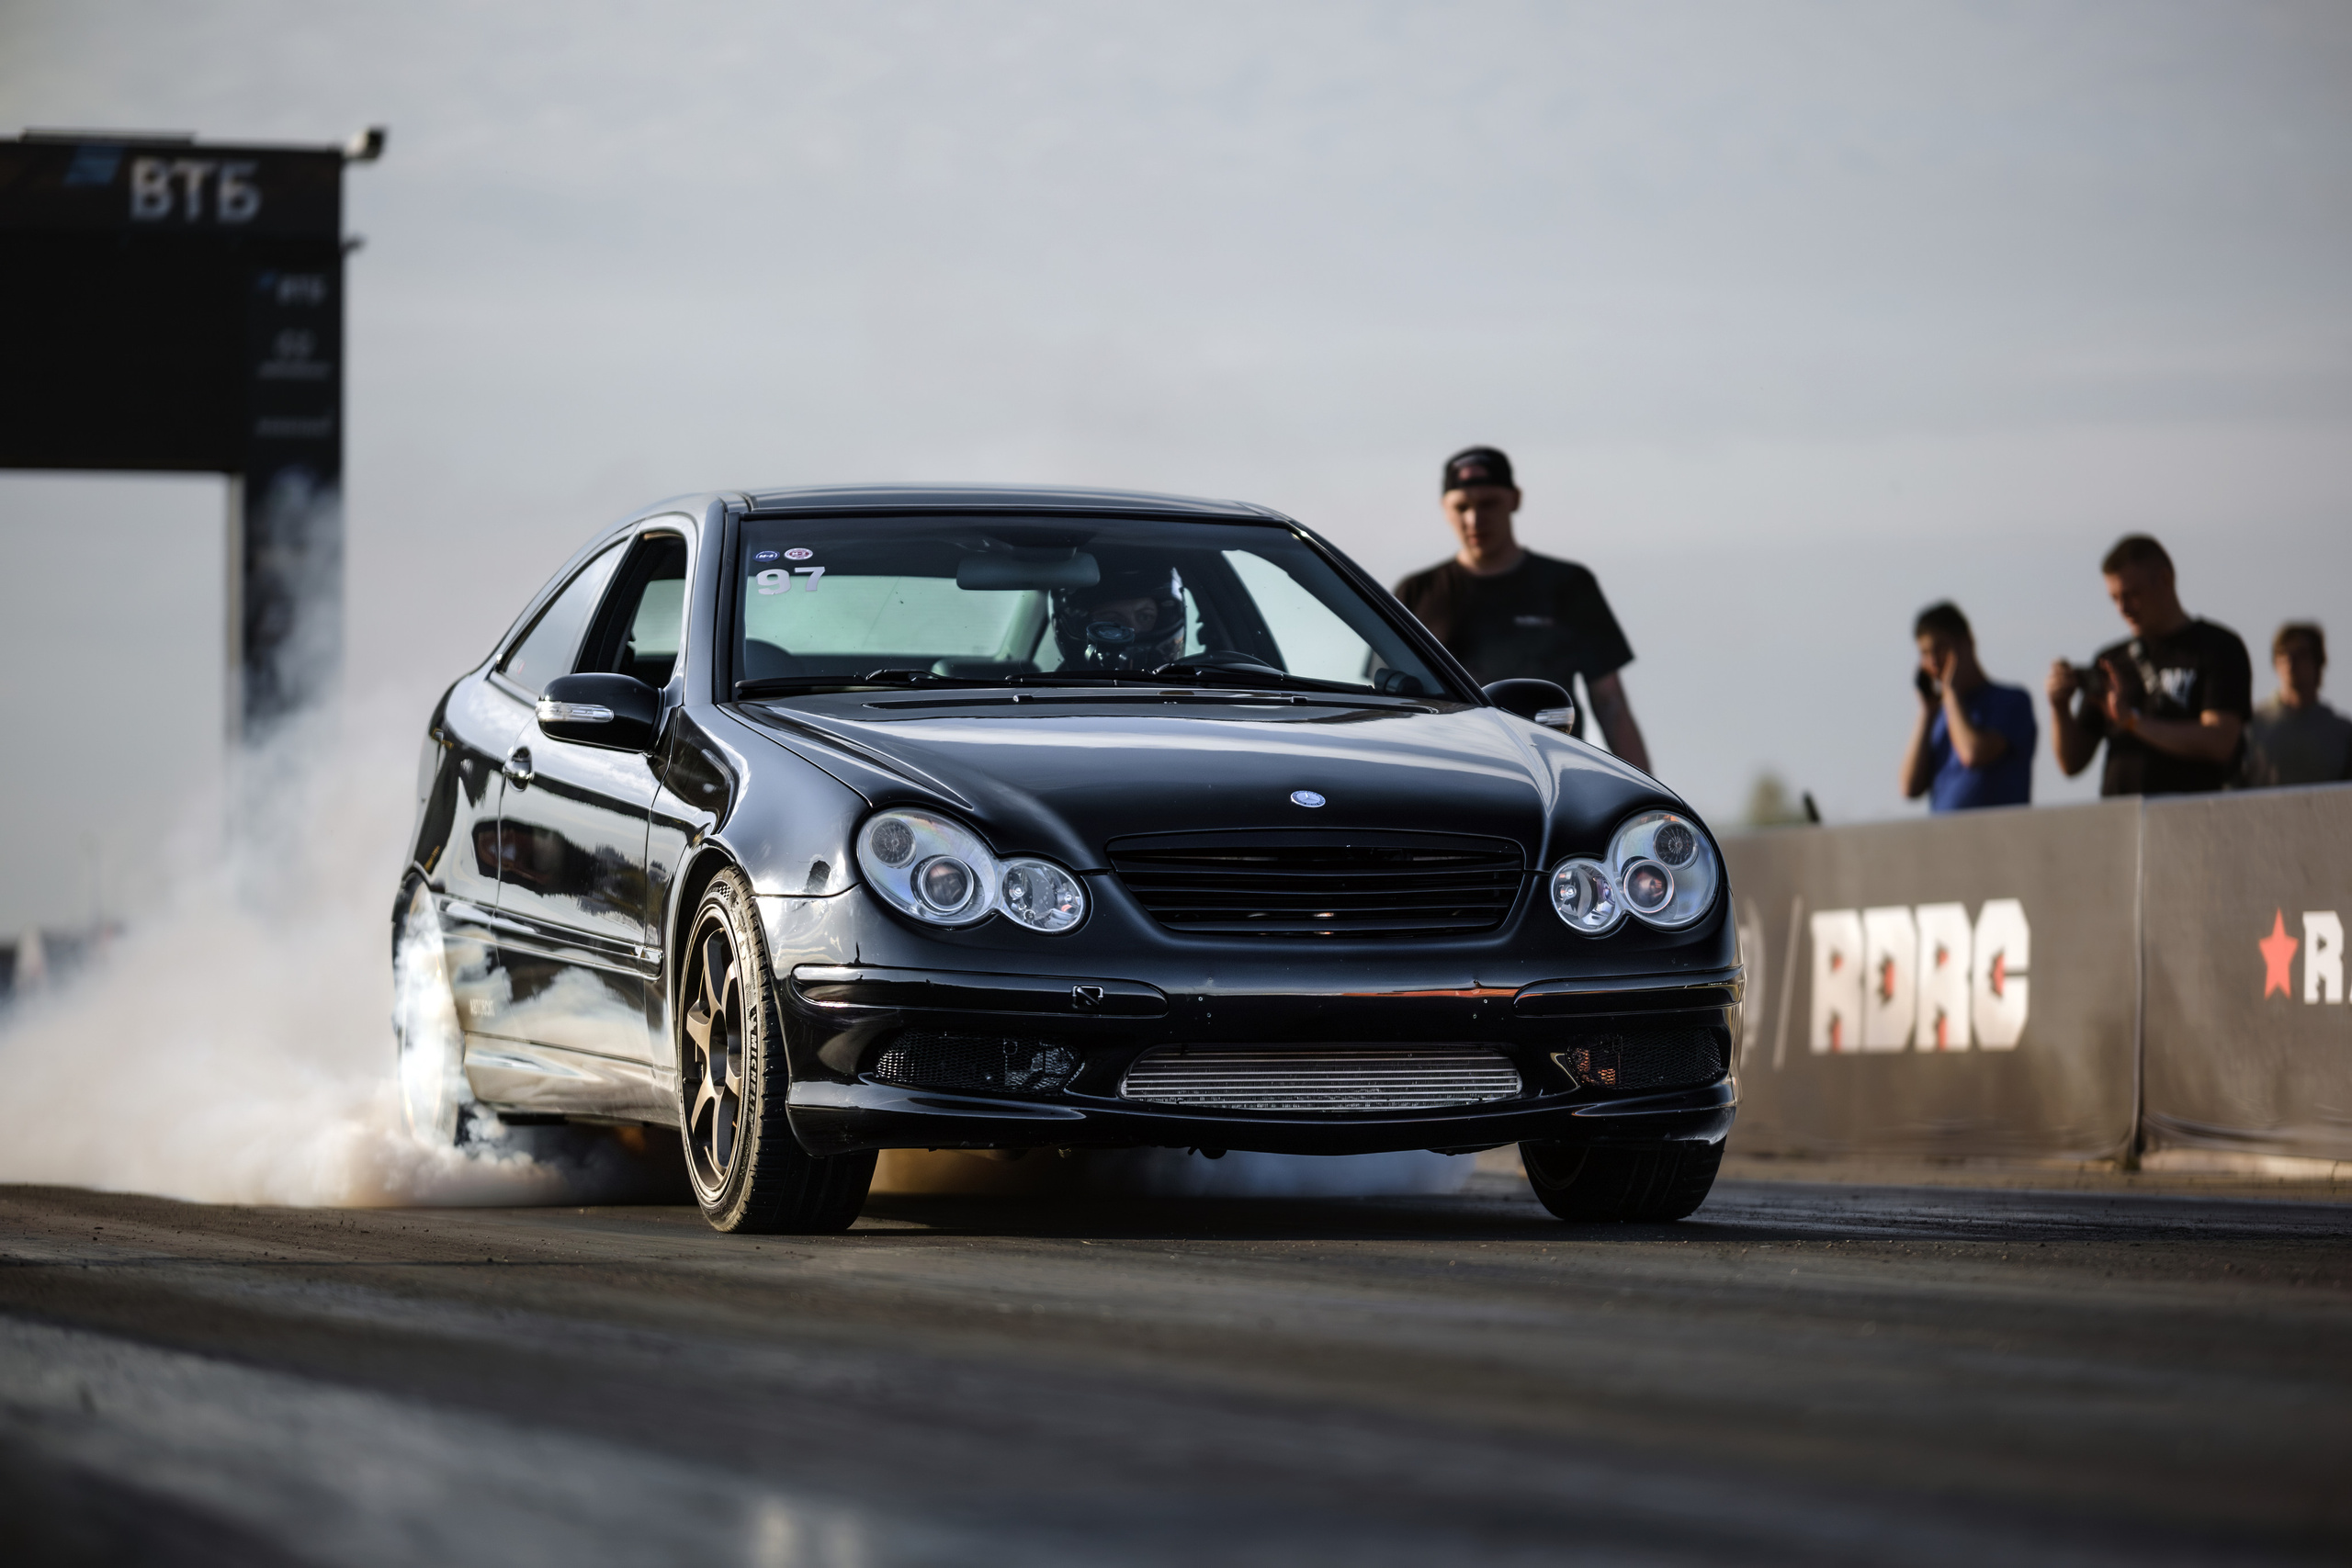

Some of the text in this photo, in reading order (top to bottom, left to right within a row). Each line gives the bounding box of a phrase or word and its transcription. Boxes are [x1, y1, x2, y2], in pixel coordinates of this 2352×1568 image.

[130, 157, 261, 221] ВТБ
[755, 566, 826, 595] 97
[1810, 898, 2030, 1055] RDRC
[2302, 909, 2352, 1005] R
[747, 1033, 758, 1126] MICHELIN
